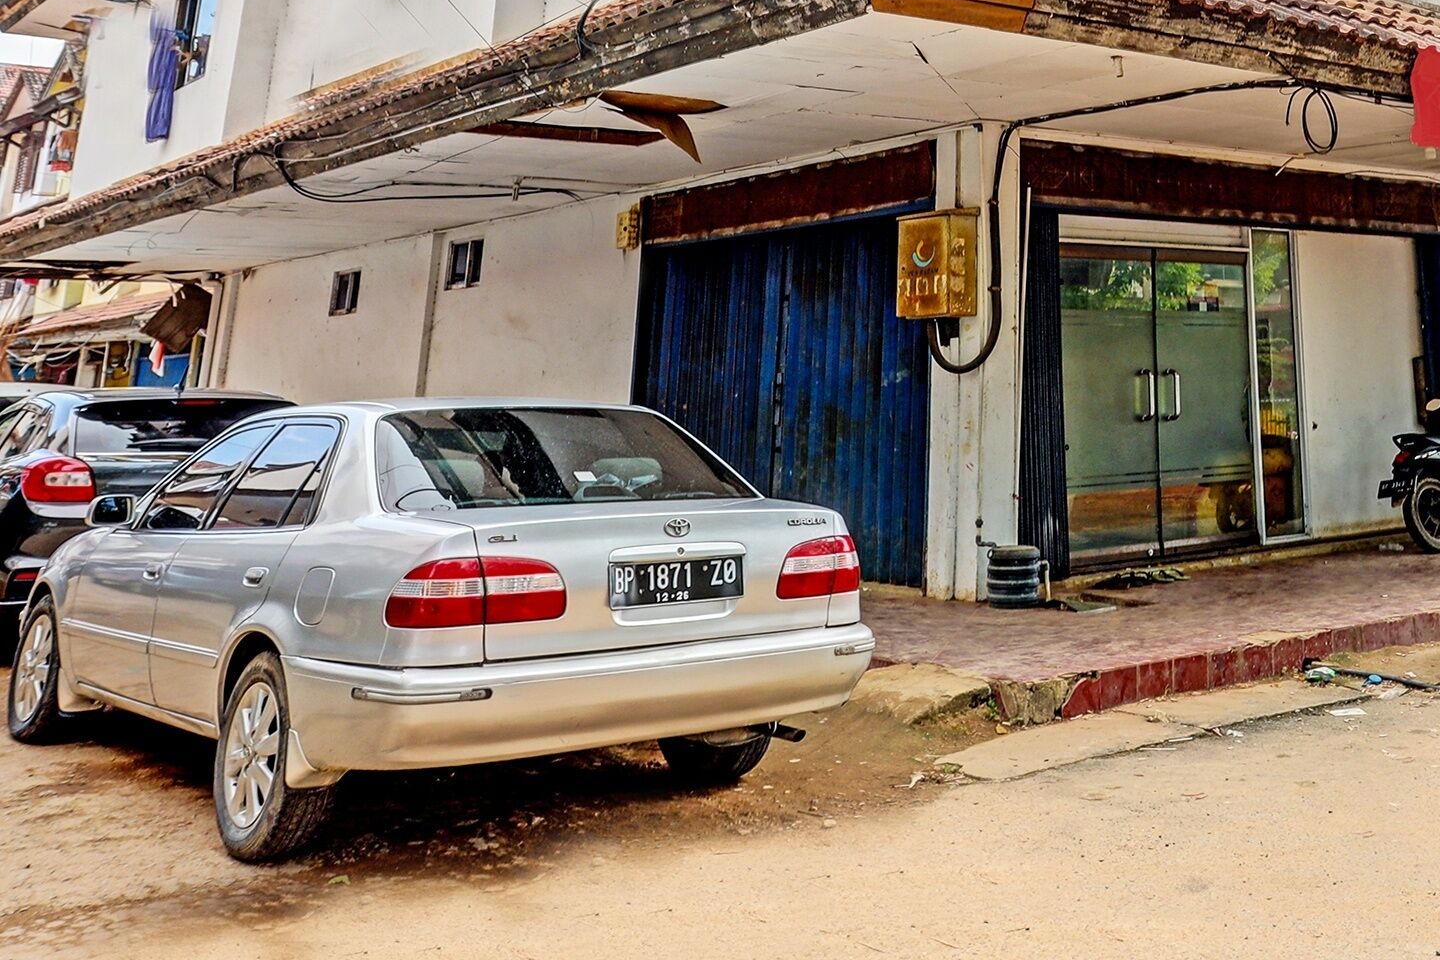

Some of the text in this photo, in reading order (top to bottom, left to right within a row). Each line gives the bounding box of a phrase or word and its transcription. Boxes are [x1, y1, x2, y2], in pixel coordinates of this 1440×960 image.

[787, 517, 827, 527] COROLLA
[615, 566, 635, 594] BP
[647, 562, 692, 591] 1871
